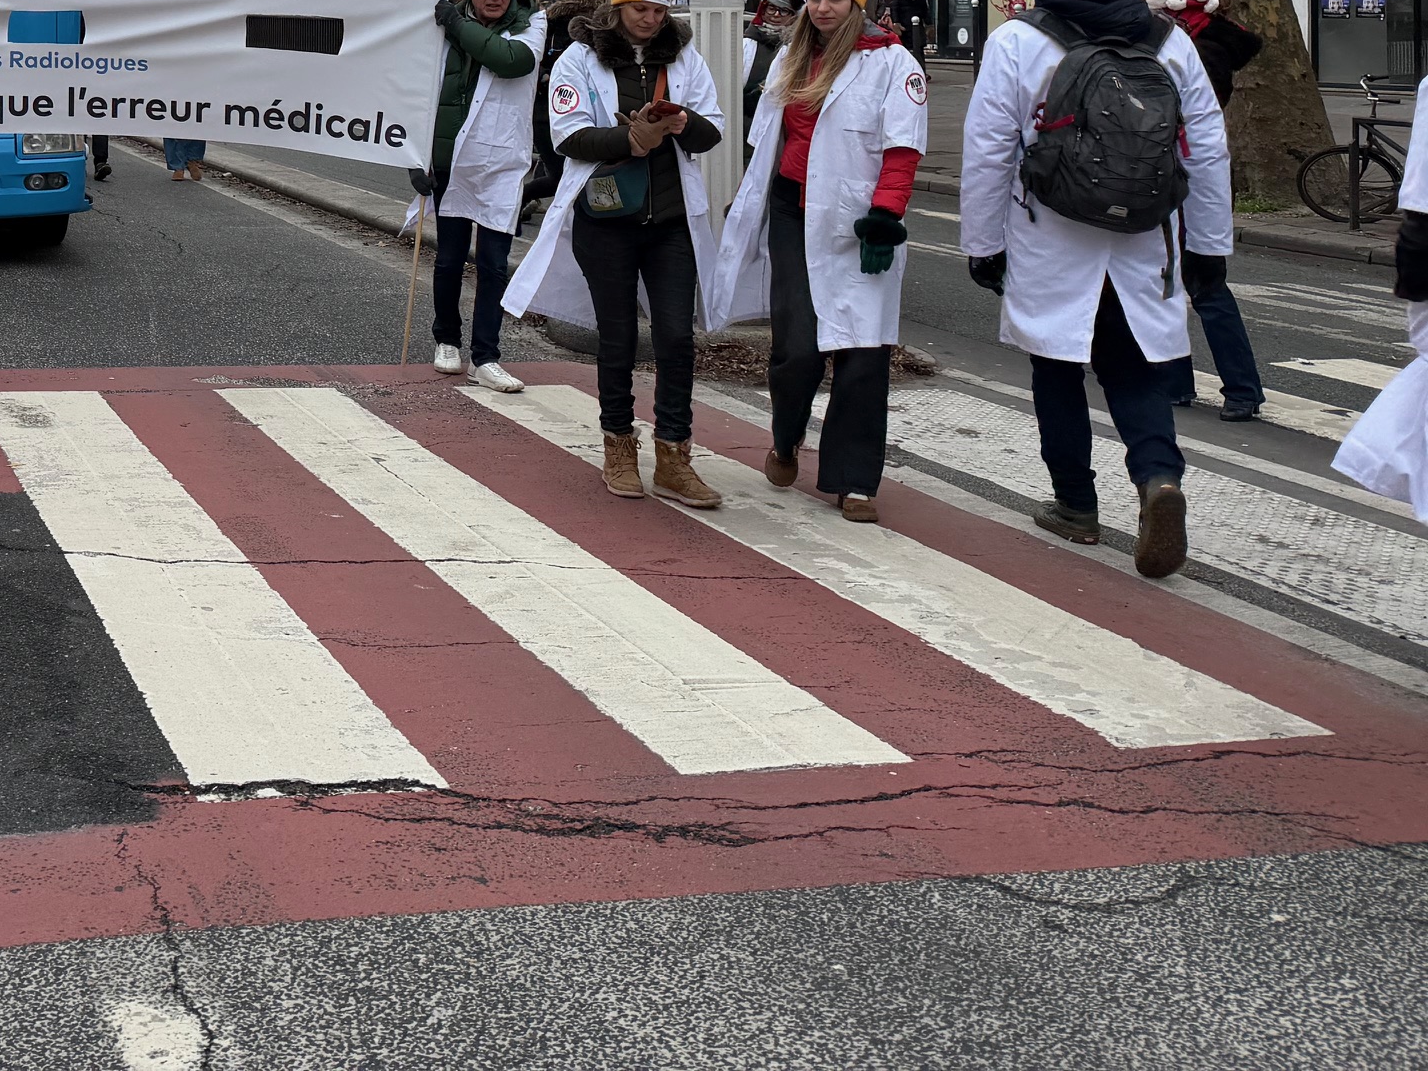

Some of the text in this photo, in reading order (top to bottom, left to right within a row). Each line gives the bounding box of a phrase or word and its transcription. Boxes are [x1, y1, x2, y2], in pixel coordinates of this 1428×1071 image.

[8, 50, 149, 75] Radiologues
[67, 86, 212, 124] l'erreur
[223, 98, 408, 148] médicale
